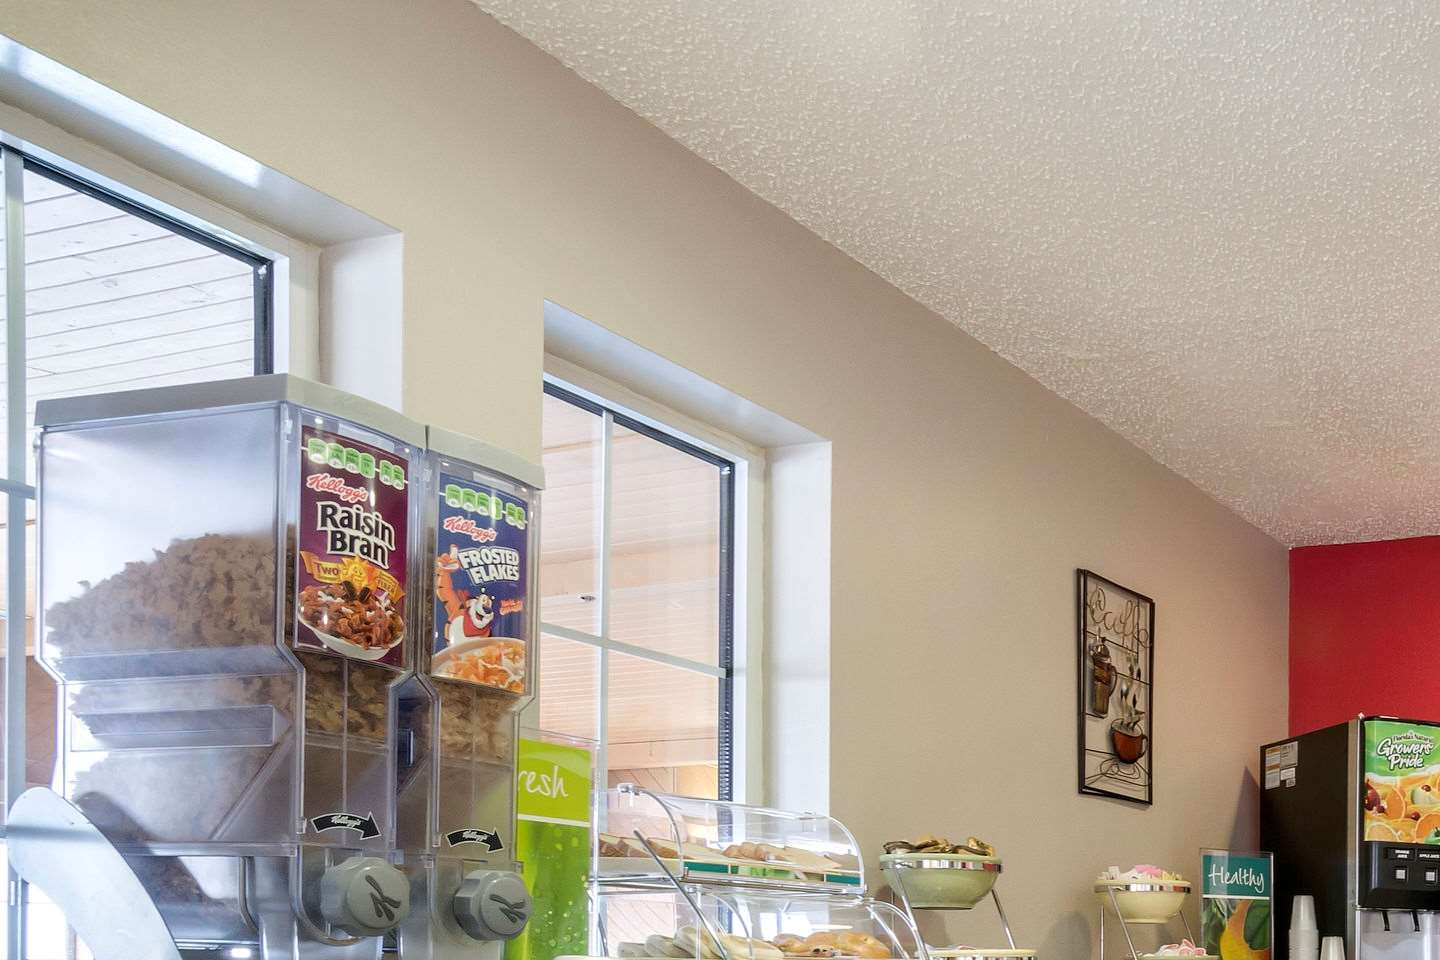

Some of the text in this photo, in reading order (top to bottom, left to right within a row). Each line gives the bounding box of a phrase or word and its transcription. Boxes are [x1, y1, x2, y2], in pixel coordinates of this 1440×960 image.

[307, 474, 368, 503] Kellogg's
[317, 501, 395, 550] Raisin
[444, 516, 497, 543] Kellogg's
[328, 529, 389, 569] Bran
[458, 547, 519, 569] FROSTED
[468, 563, 520, 585] FLAKES
[1388, 754, 1425, 771] Pride
[518, 764, 569, 799] resh
[1208, 863, 1265, 894] Healthy
